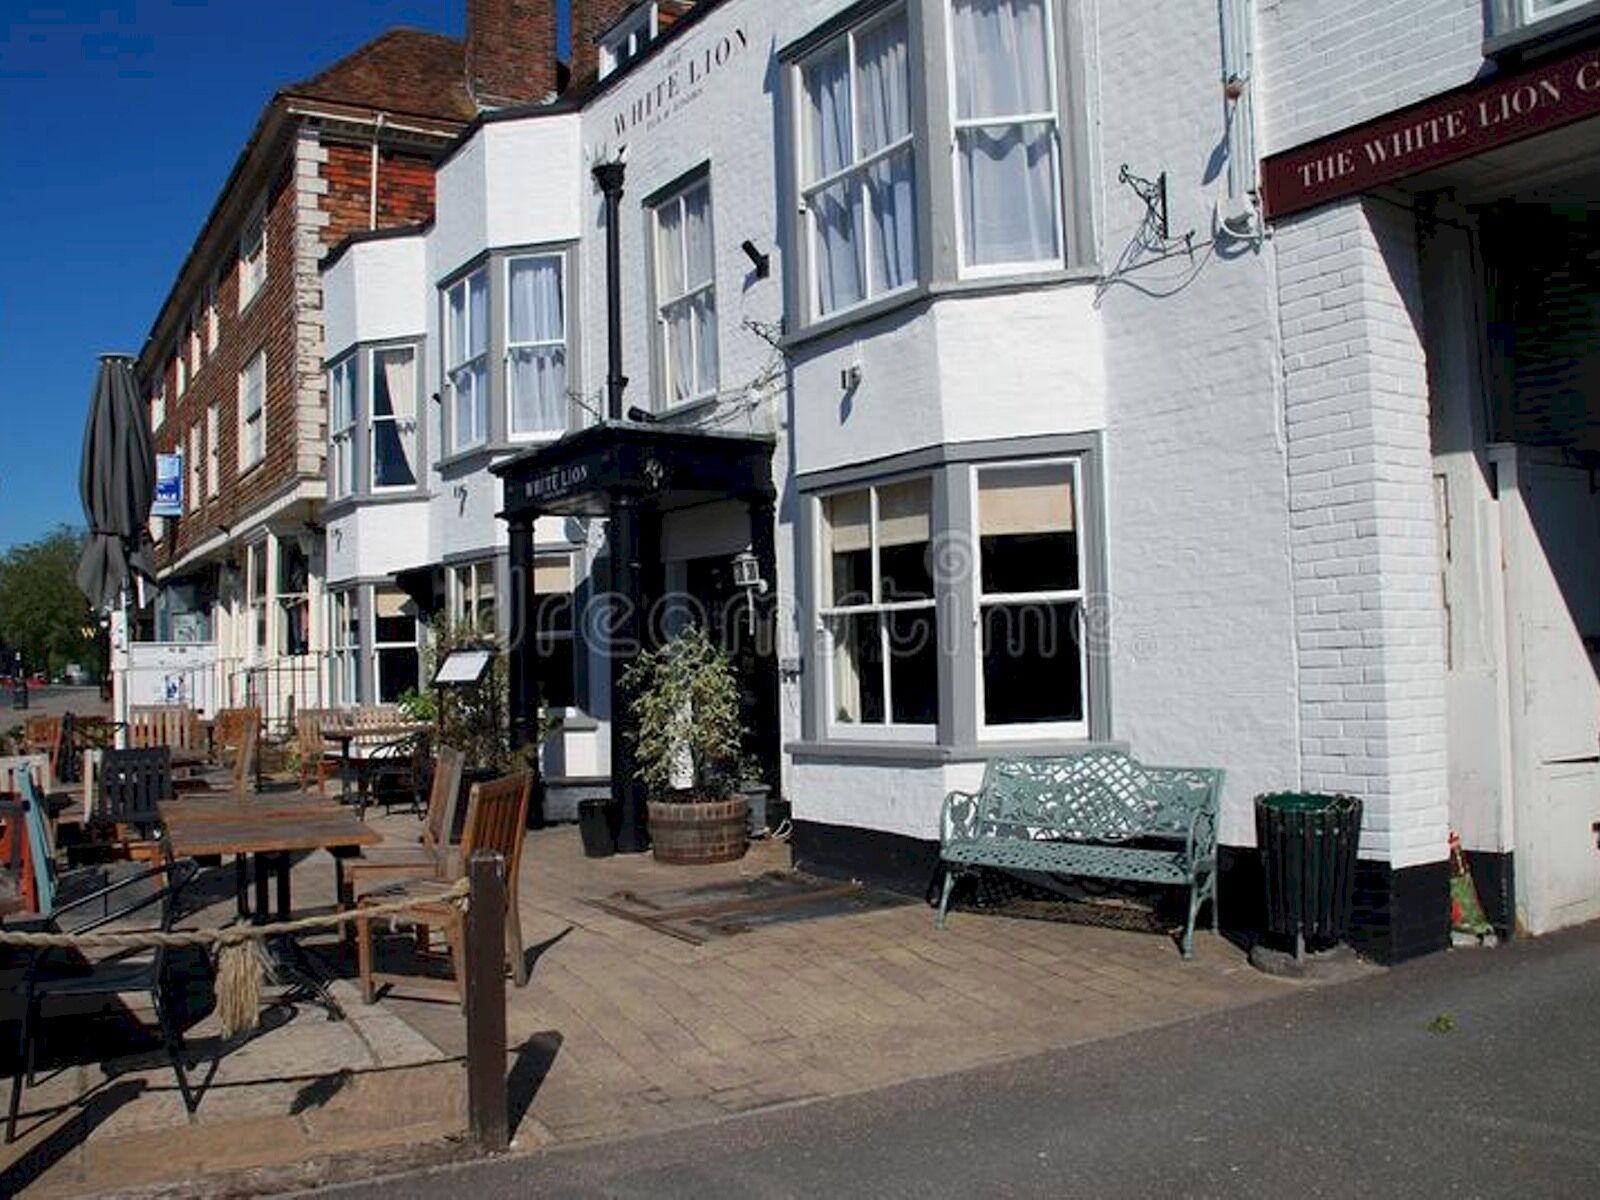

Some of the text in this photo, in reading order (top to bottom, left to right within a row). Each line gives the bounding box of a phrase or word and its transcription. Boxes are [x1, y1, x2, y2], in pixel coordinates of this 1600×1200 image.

[613, 71, 680, 136] WHITE
[689, 25, 748, 84] LION
[1298, 149, 1355, 187] THE
[1363, 110, 1466, 165] WHITE
[1478, 76, 1561, 127] LION
[561, 465, 588, 486] LION
